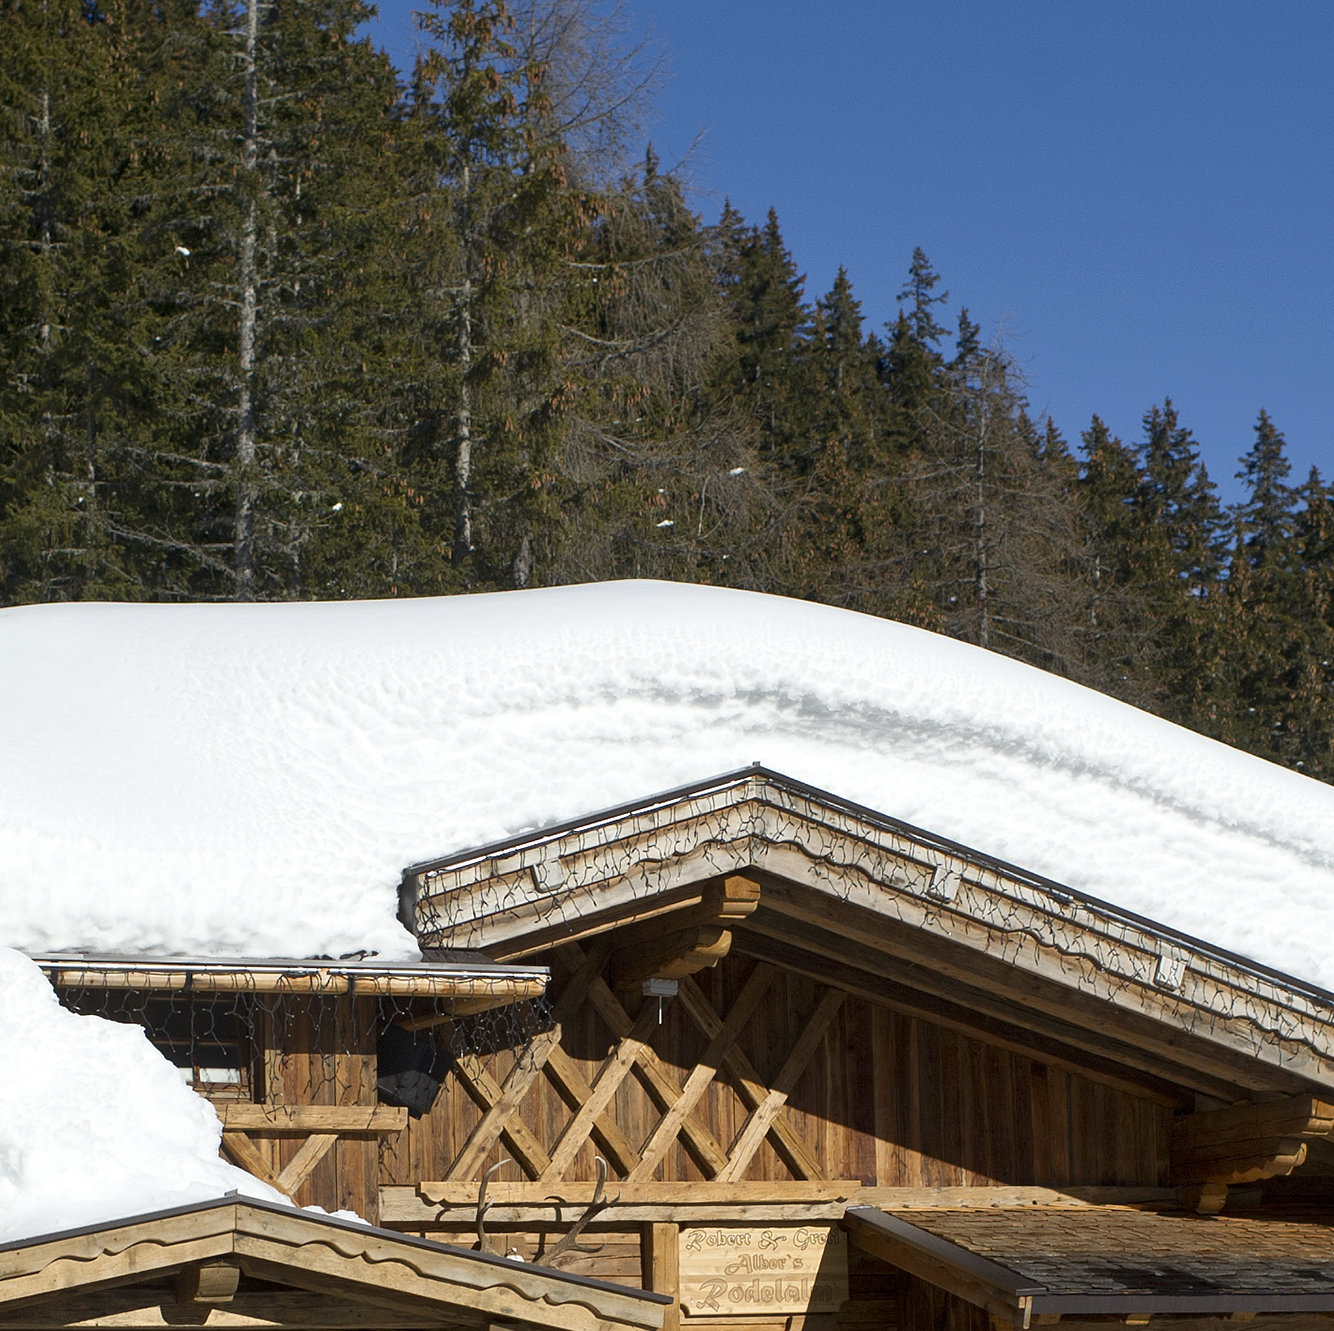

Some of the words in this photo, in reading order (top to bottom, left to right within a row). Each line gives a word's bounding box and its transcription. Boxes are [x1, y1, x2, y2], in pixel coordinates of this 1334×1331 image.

[686, 1230, 752, 1251] Robert
[758, 1230, 787, 1250] &
[696, 1278, 834, 1312] Rodelalm
